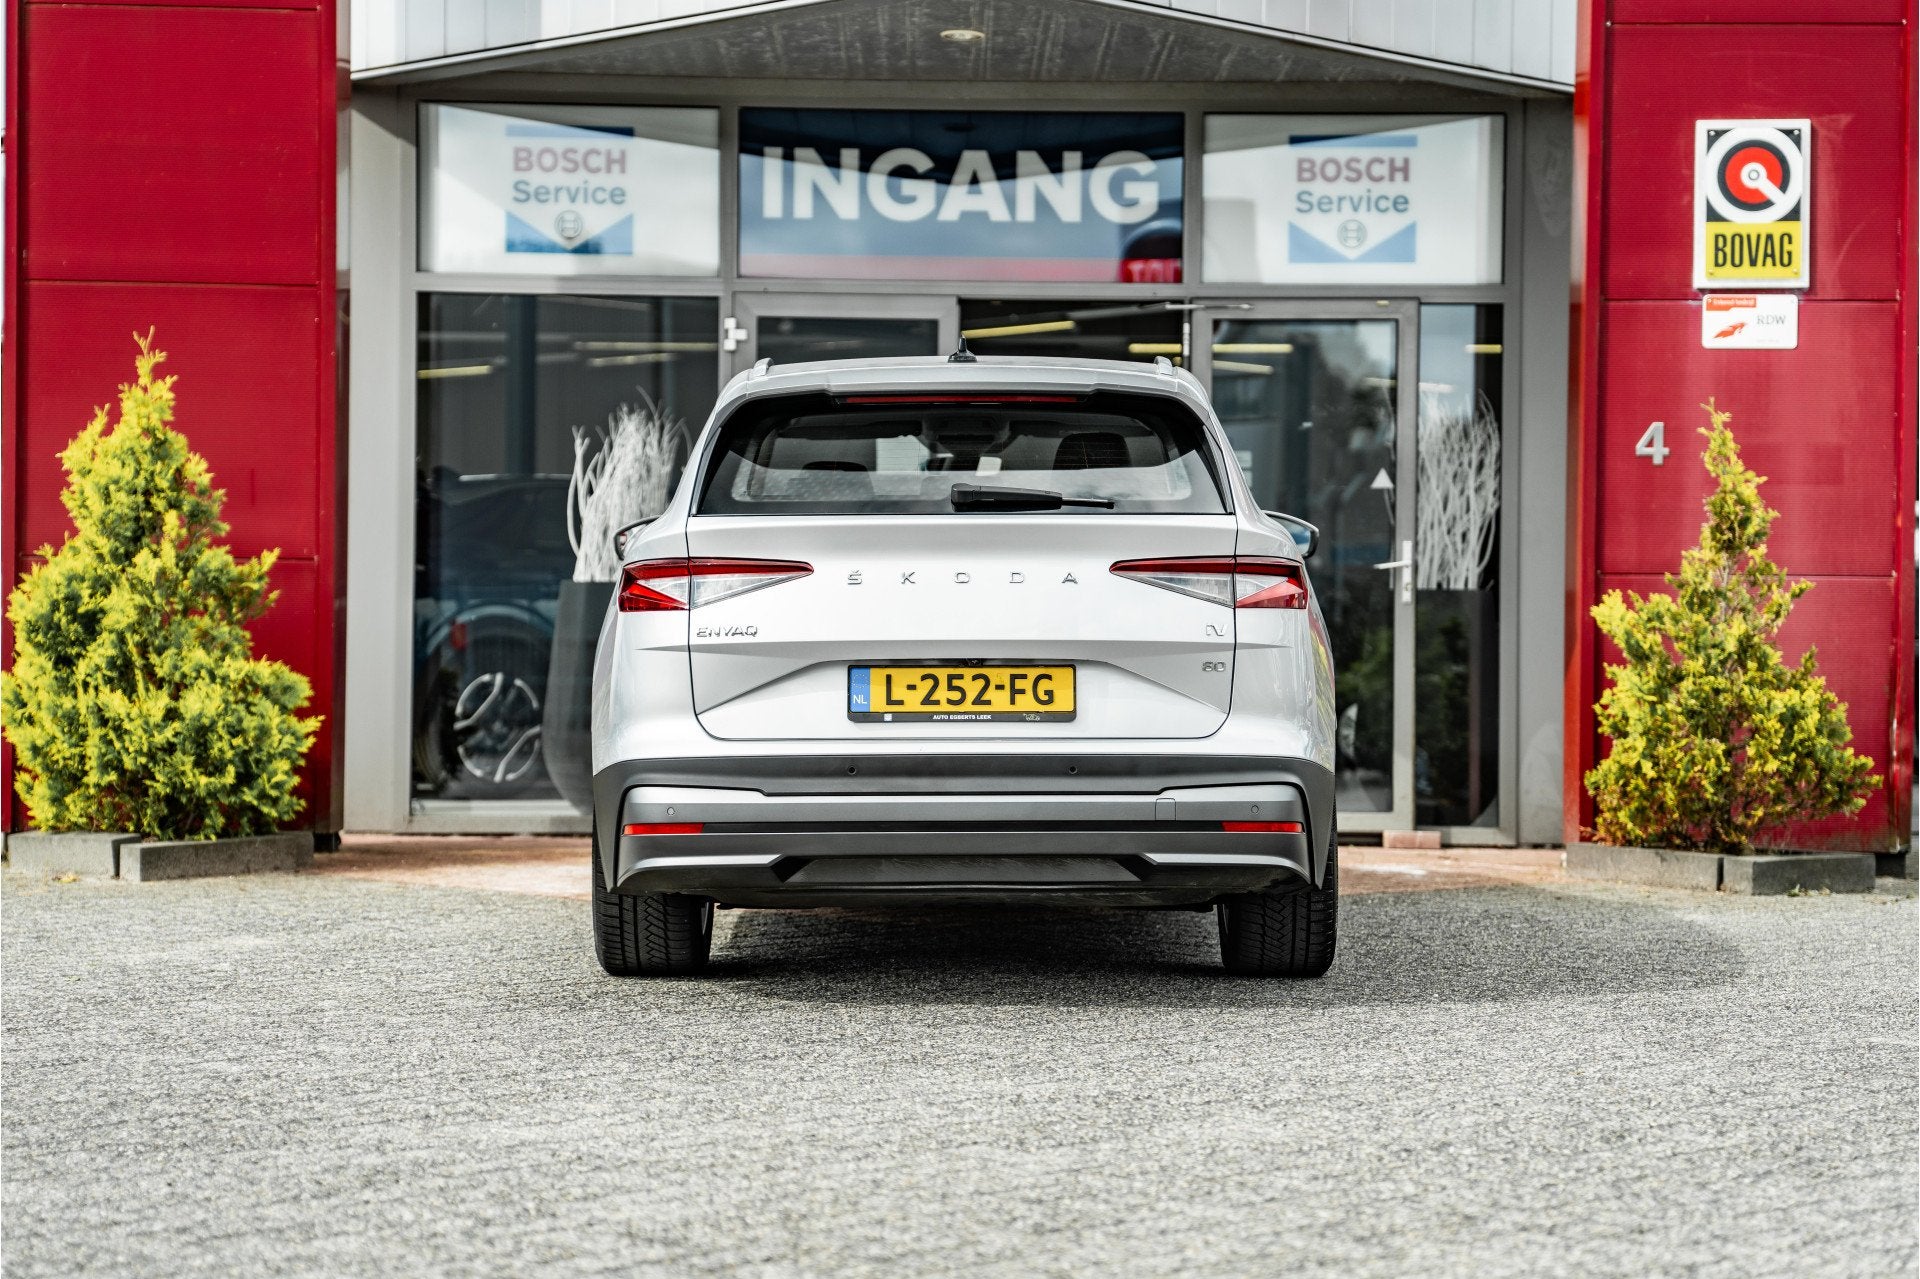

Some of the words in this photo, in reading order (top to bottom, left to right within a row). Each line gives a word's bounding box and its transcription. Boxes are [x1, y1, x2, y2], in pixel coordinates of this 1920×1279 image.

[512, 146, 627, 174] BOSCH
[1296, 157, 1410, 182] BOSCH
[512, 180, 627, 205] Service
[761, 146, 1160, 224] INGANG
[1296, 188, 1410, 213] Service
[1713, 232, 1794, 269] BOVAG
[1756, 314, 1787, 325] RDW
[1635, 421, 1671, 466] 4
[696, 625, 758, 638] ENYAQ
[853, 694, 868, 704] NL
[885, 673, 1055, 707] L-252-FG
